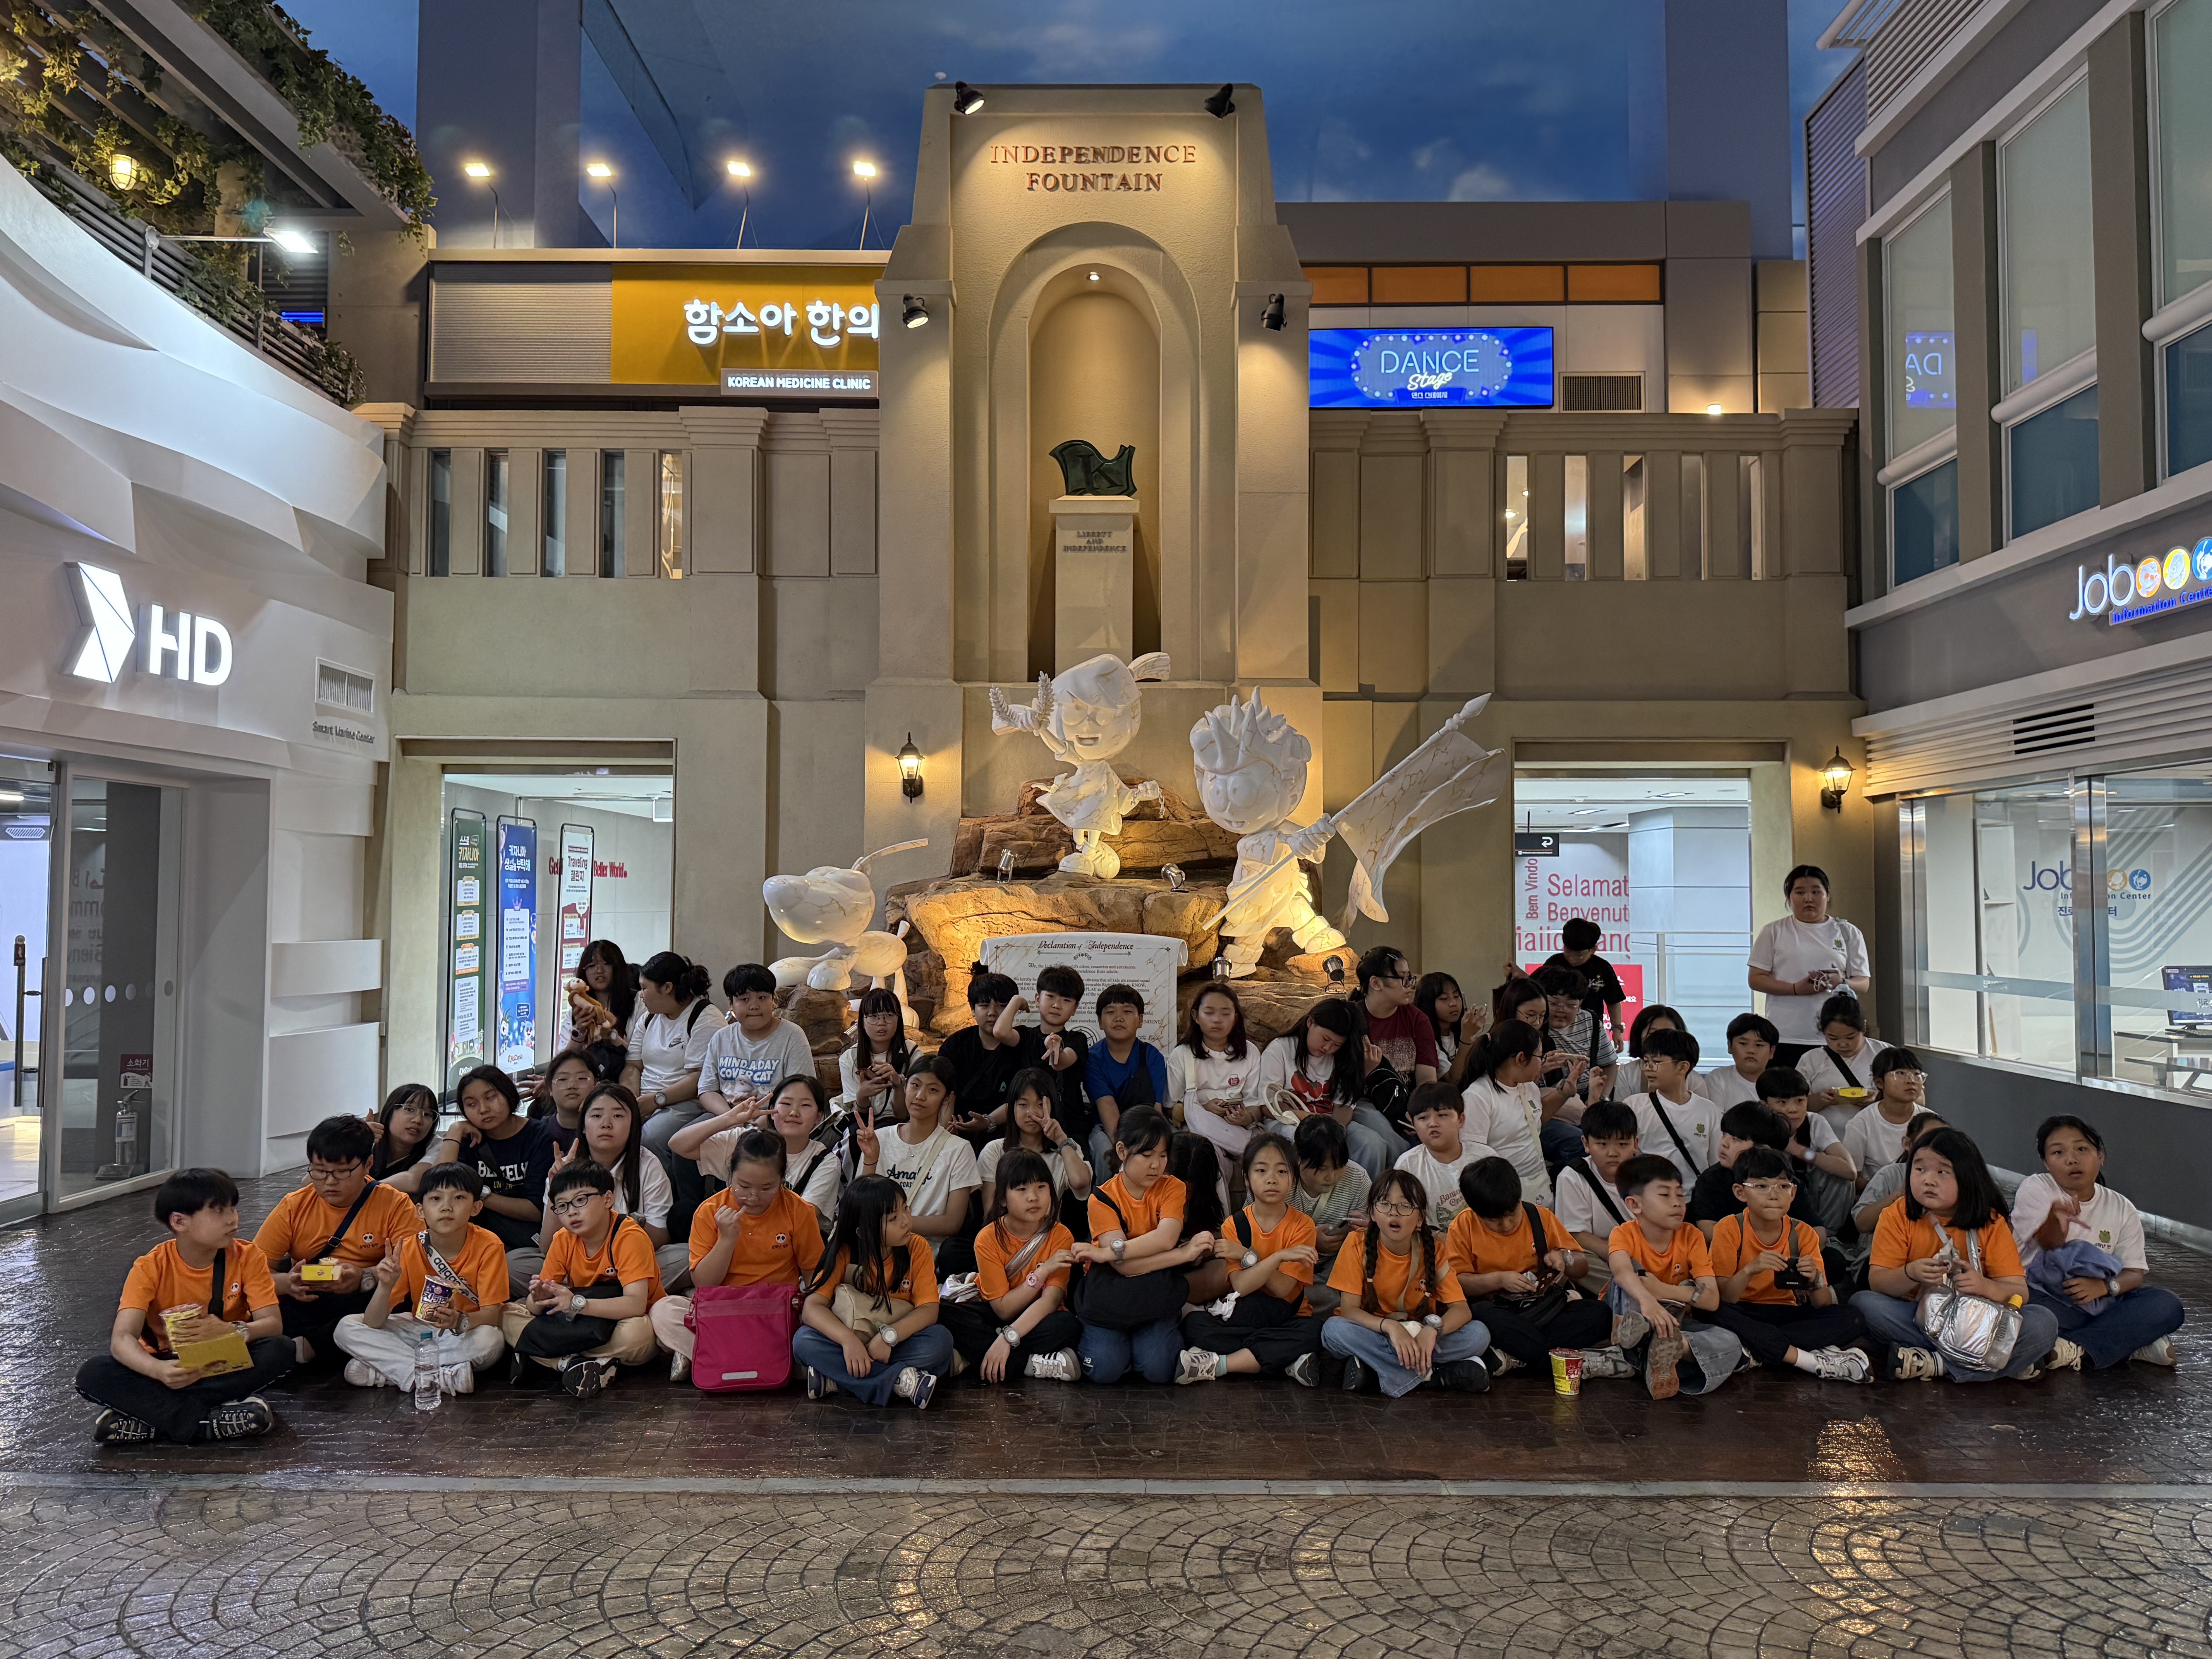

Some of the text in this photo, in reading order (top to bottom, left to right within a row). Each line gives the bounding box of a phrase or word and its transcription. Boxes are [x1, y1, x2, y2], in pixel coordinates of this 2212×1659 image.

[991, 145, 1196, 163] INDEPENDENCE
[1027, 172, 1163, 191] FOUNTAIN
[683, 299, 798, 346] 함소아
[1381, 349, 1479, 373] DANCE
[727, 376, 871, 390] KOREAN MEDICINE CLINIC
[1407, 371, 1453, 390] Stage
[2112, 597, 2176, 624] Information
[149, 604, 233, 686] HD
[459, 847, 479, 861] 키자니아
[568, 855, 588, 870] Traveling
[571, 870, 584, 882] 챌린지
[1547, 873, 1629, 897] Selamat
[1524, 858, 1539, 920] Bem Vindo
[1038, 940, 1076, 949] Declaration
[1085, 939, 1134, 952] Independence
[127, 1058, 149, 1067] 소화기
[720, 1067, 774, 1082] COVER CAT
